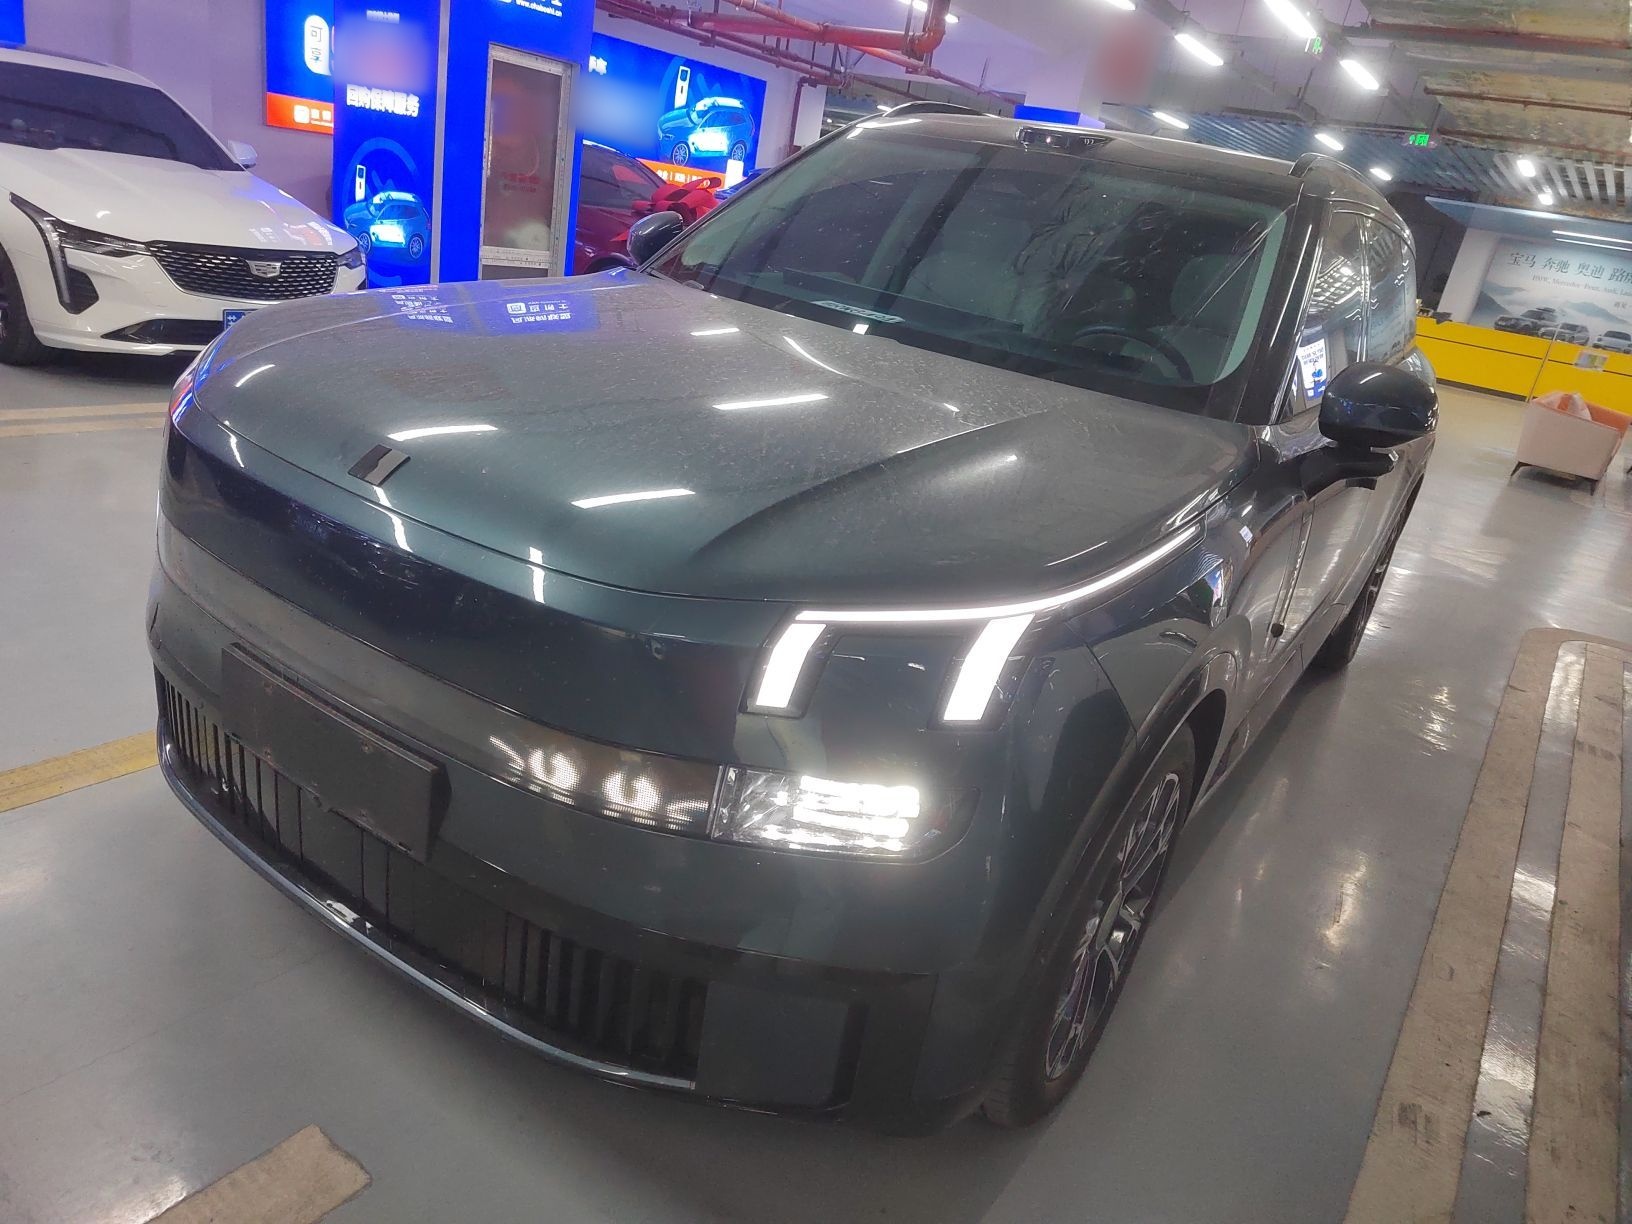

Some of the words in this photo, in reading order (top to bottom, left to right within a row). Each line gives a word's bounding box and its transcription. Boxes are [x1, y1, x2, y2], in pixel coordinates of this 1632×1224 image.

[1507, 252, 1536, 268] 宝马
[1541, 257, 1570, 274] 奔驰
[1575, 262, 1605, 279] 奥迪
